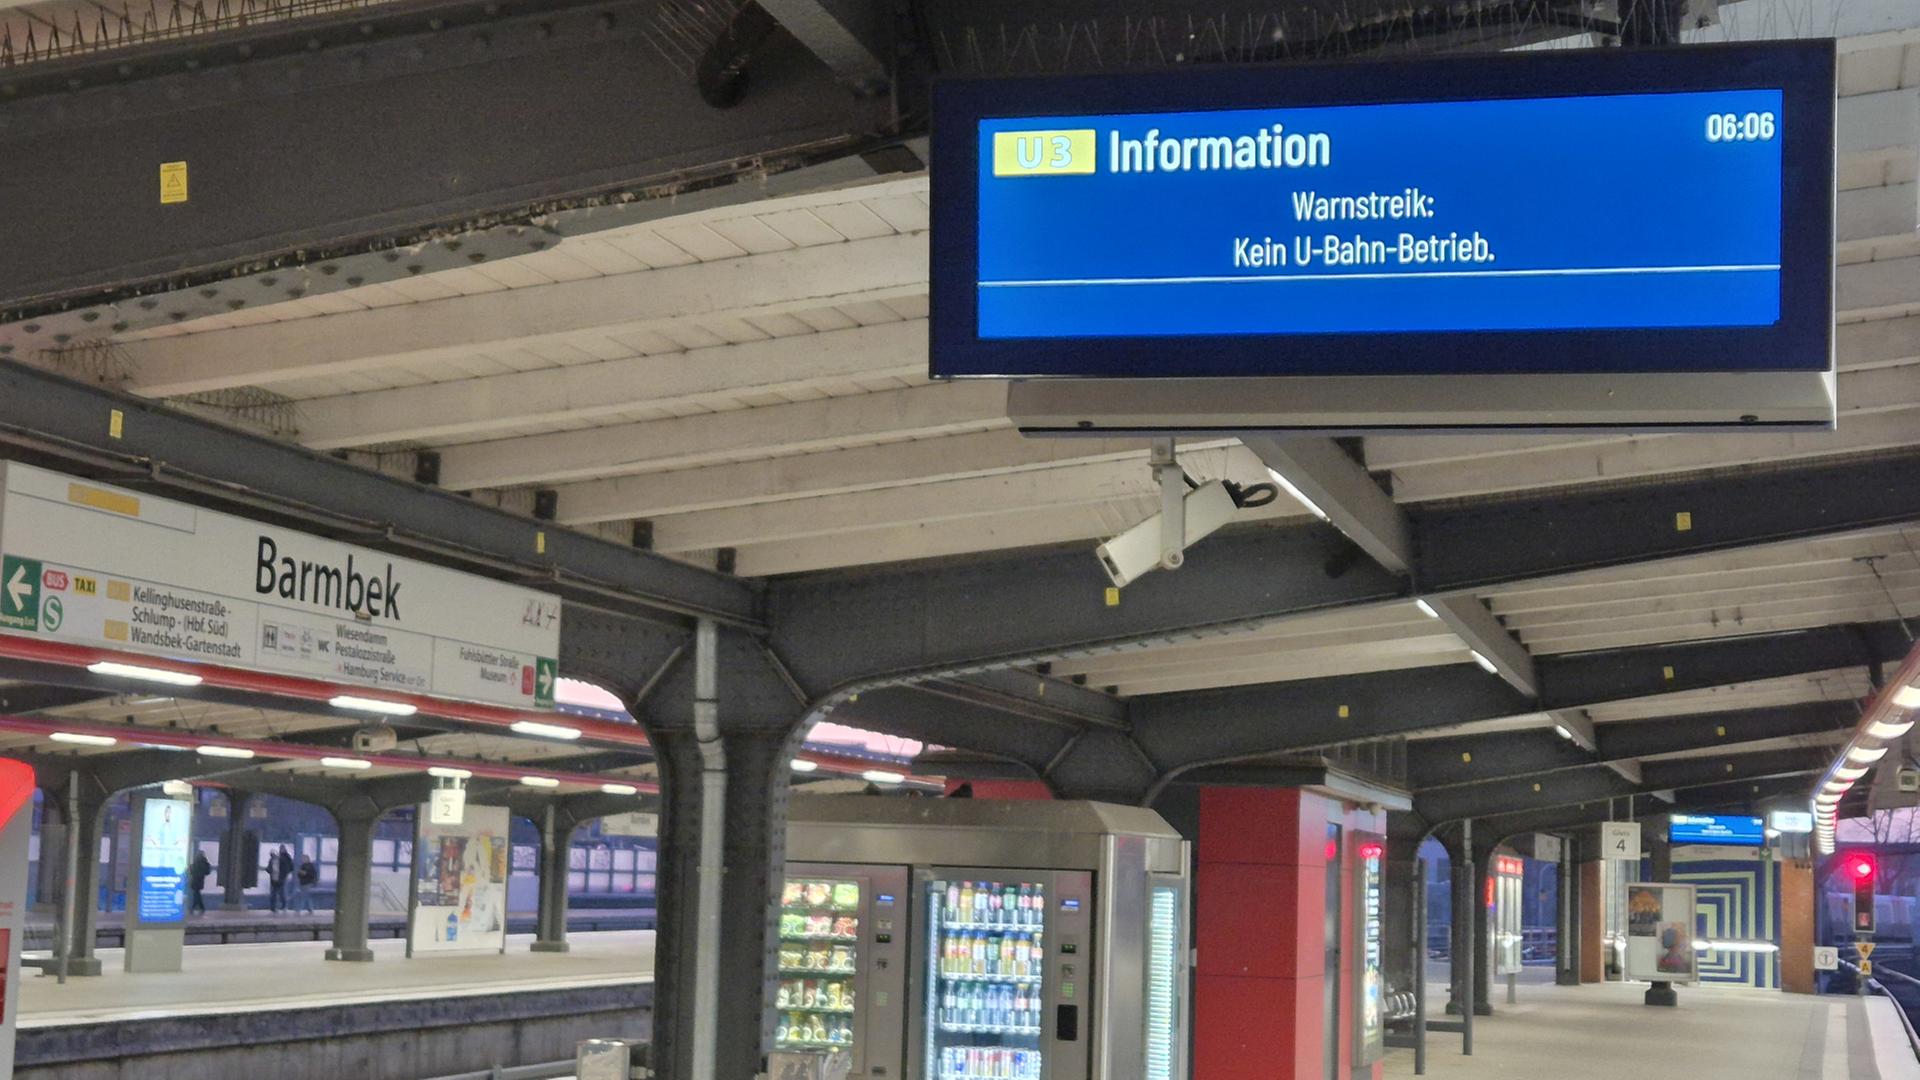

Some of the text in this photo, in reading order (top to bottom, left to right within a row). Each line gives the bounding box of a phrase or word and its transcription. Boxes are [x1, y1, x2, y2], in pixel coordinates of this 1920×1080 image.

[1706, 112, 1775, 141] 06:06
[1110, 123, 1330, 173] Information
[1292, 188, 1435, 221] Warnstreik:
[1234, 231, 1496, 267] Kein U-Bahn-Betrieb.
[74, 577, 97, 593] TAXI
[255, 536, 401, 620] Barmbek
[133, 586, 226, 617] Kellinghusenstraße
[131, 606, 175, 630] Schlump
[131, 625, 242, 658] Wandsbek-Gartenstadt
[343, 662, 379, 684] Hamburg
[442, 804, 451, 817] 2
[1616, 839, 1626, 853] 4
